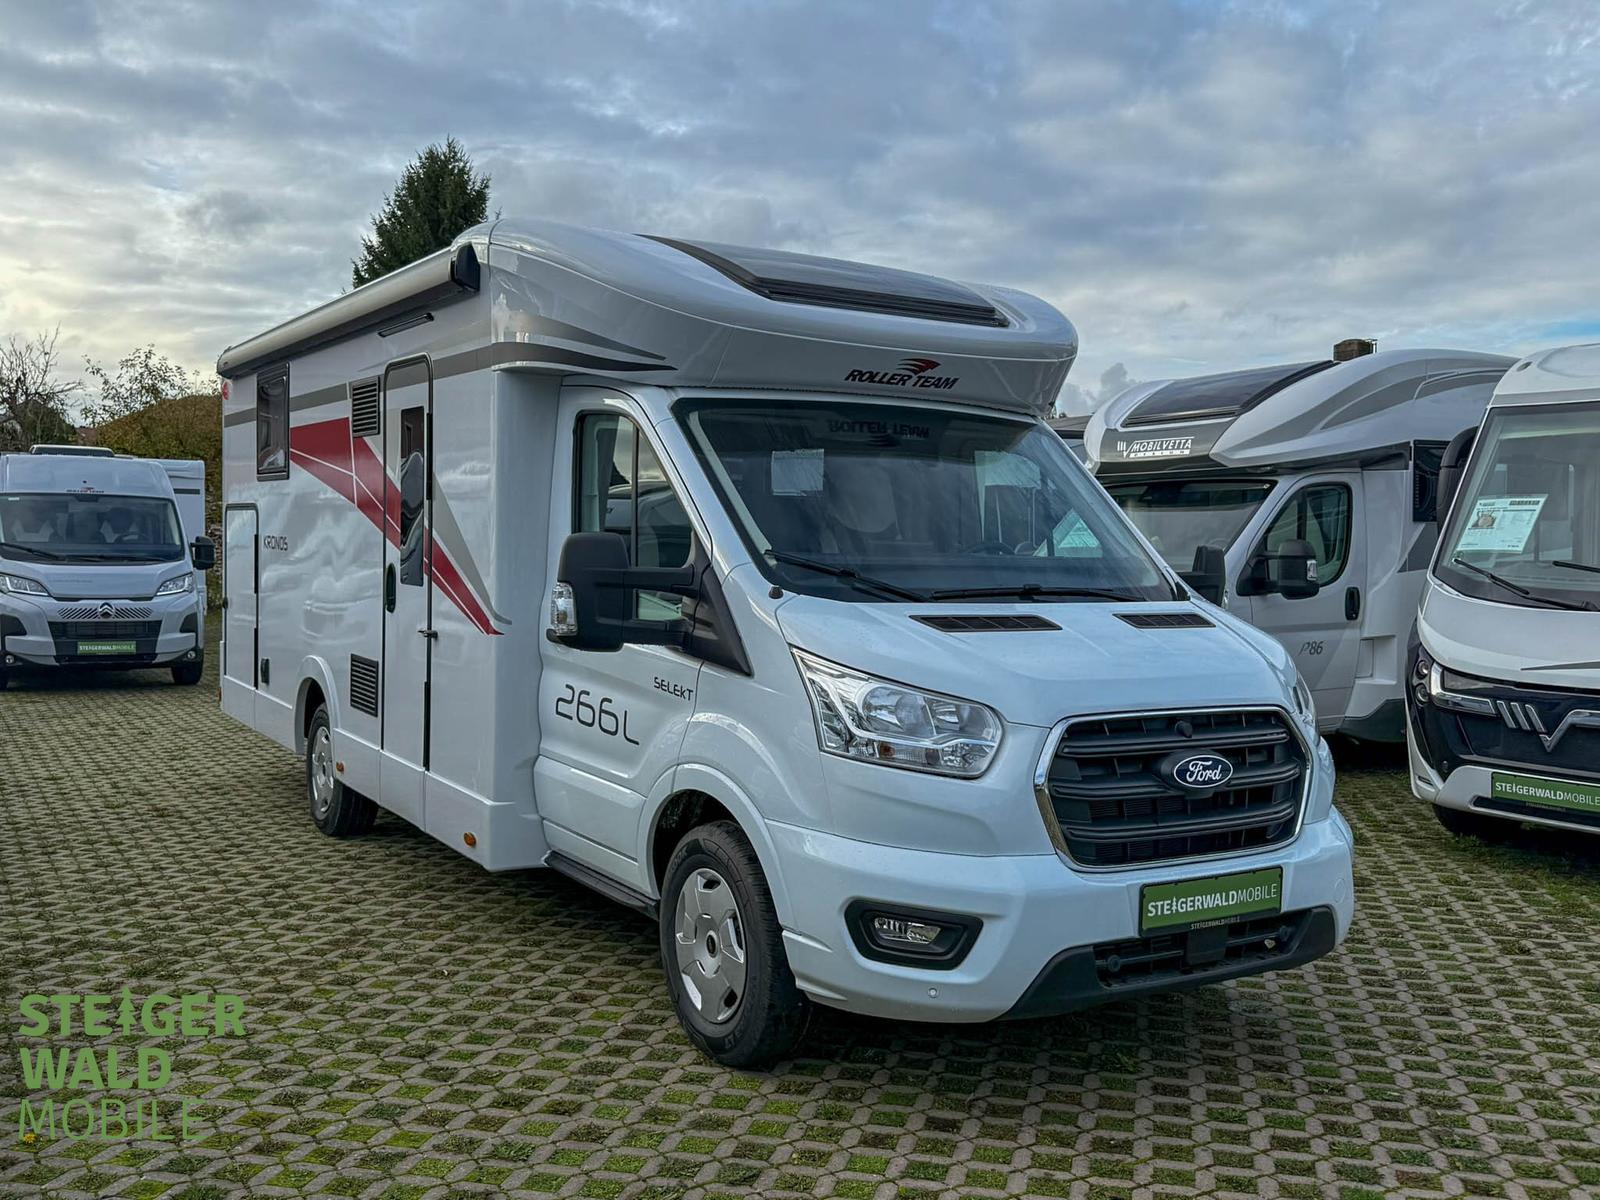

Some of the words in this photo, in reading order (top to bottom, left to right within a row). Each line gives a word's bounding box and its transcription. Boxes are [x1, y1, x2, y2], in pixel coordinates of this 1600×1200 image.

[844, 369, 913, 386] ROLLER
[912, 376, 960, 390] TEAM
[1131, 439, 1192, 452] MOBILVETTA
[263, 535, 288, 551] KRONOS
[653, 676, 694, 701] SELEKT
[555, 683, 640, 746] 266L
[1186, 760, 1223, 783] Ford
[1495, 782, 1600, 807] STEIGERWALDMOBILE
[1148, 884, 1277, 917] STEIGERWALDMOBILE
